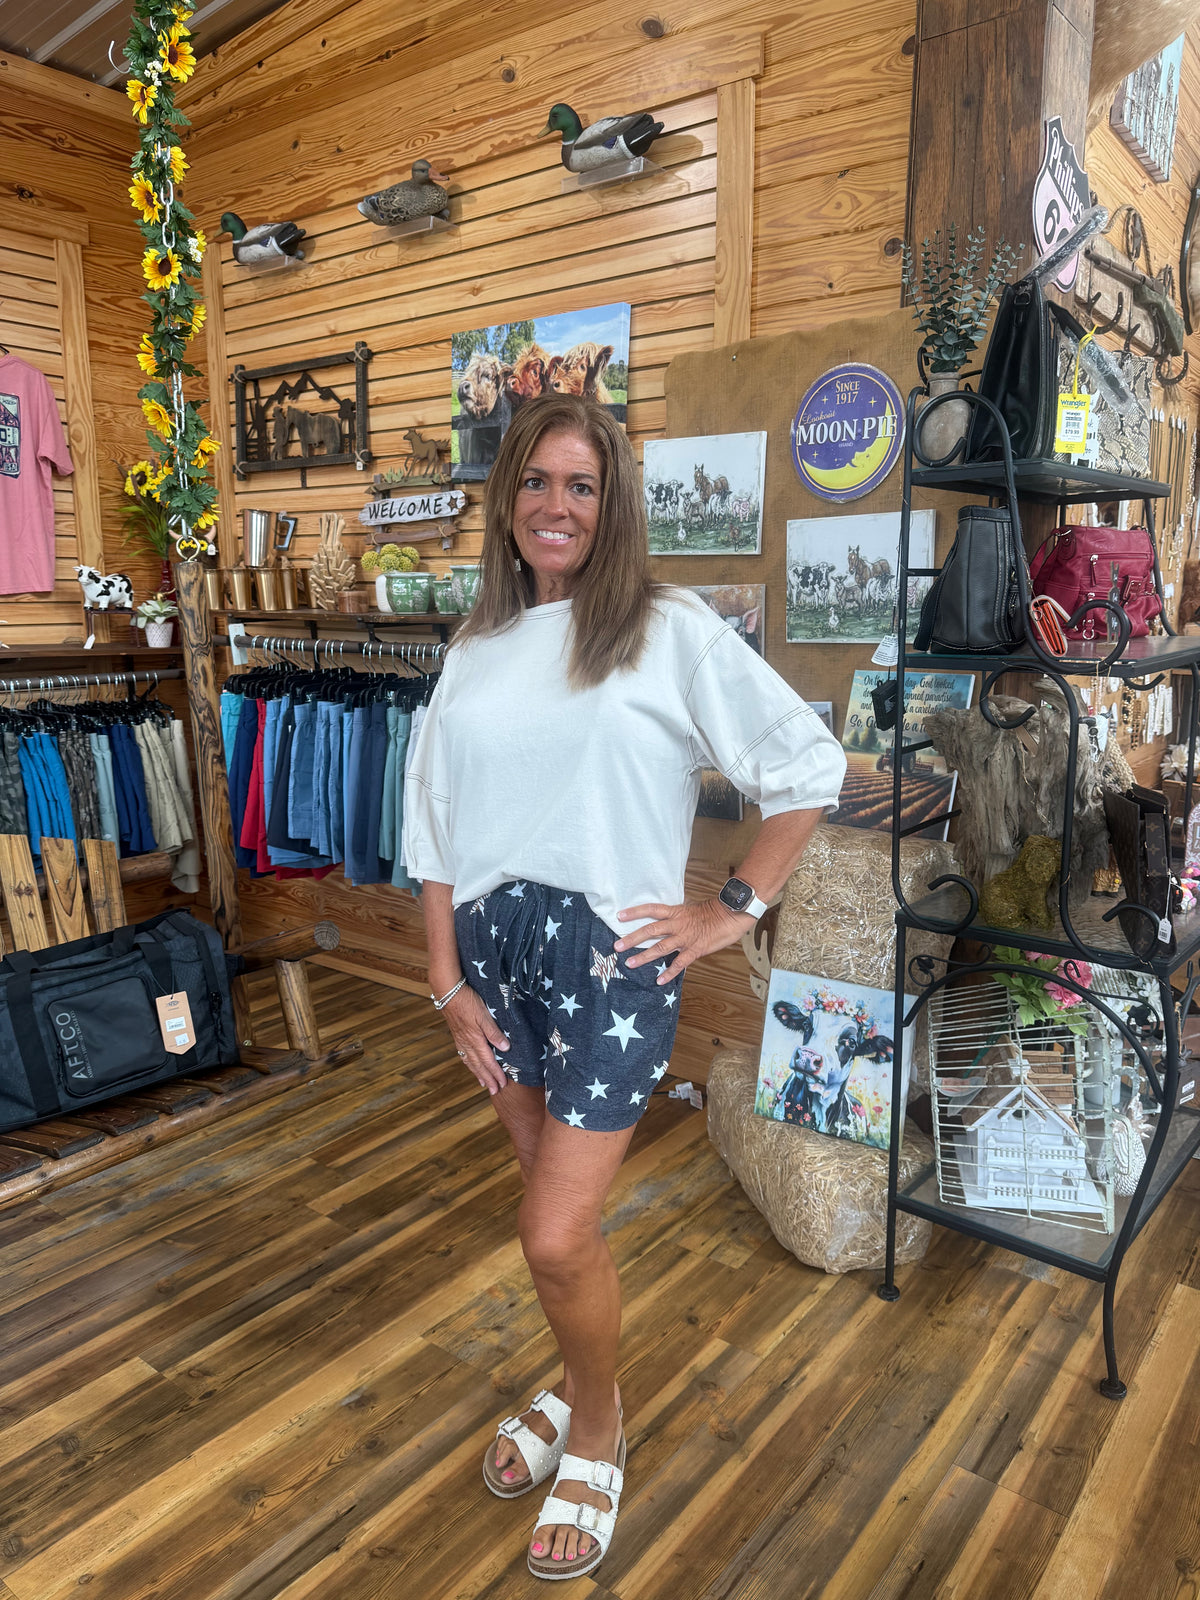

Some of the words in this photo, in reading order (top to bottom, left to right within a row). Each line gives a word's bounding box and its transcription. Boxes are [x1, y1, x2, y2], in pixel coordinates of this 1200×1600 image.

[1049, 127, 1085, 223] Phillips
[1044, 199, 1070, 244] 6
[835, 381, 860, 393] SINCE
[836, 391, 859, 405] 1917
[1060, 399, 1087, 409] Wrangler
[803, 410, 836, 425] Lookout
[797, 418, 857, 446] MOON
[862, 414, 898, 440] PIE
[368, 497, 443, 519] WELCOME
[864, 675, 873, 686] On
[920, 677, 933, 688] God
[934, 678, 955, 689] looked
[924, 691, 953, 705] paradise
[861, 701, 873, 711] and
[866, 715, 877, 728] Go
[912, 723, 918, 731] a
[56, 1012, 88, 1079] AFTCO
